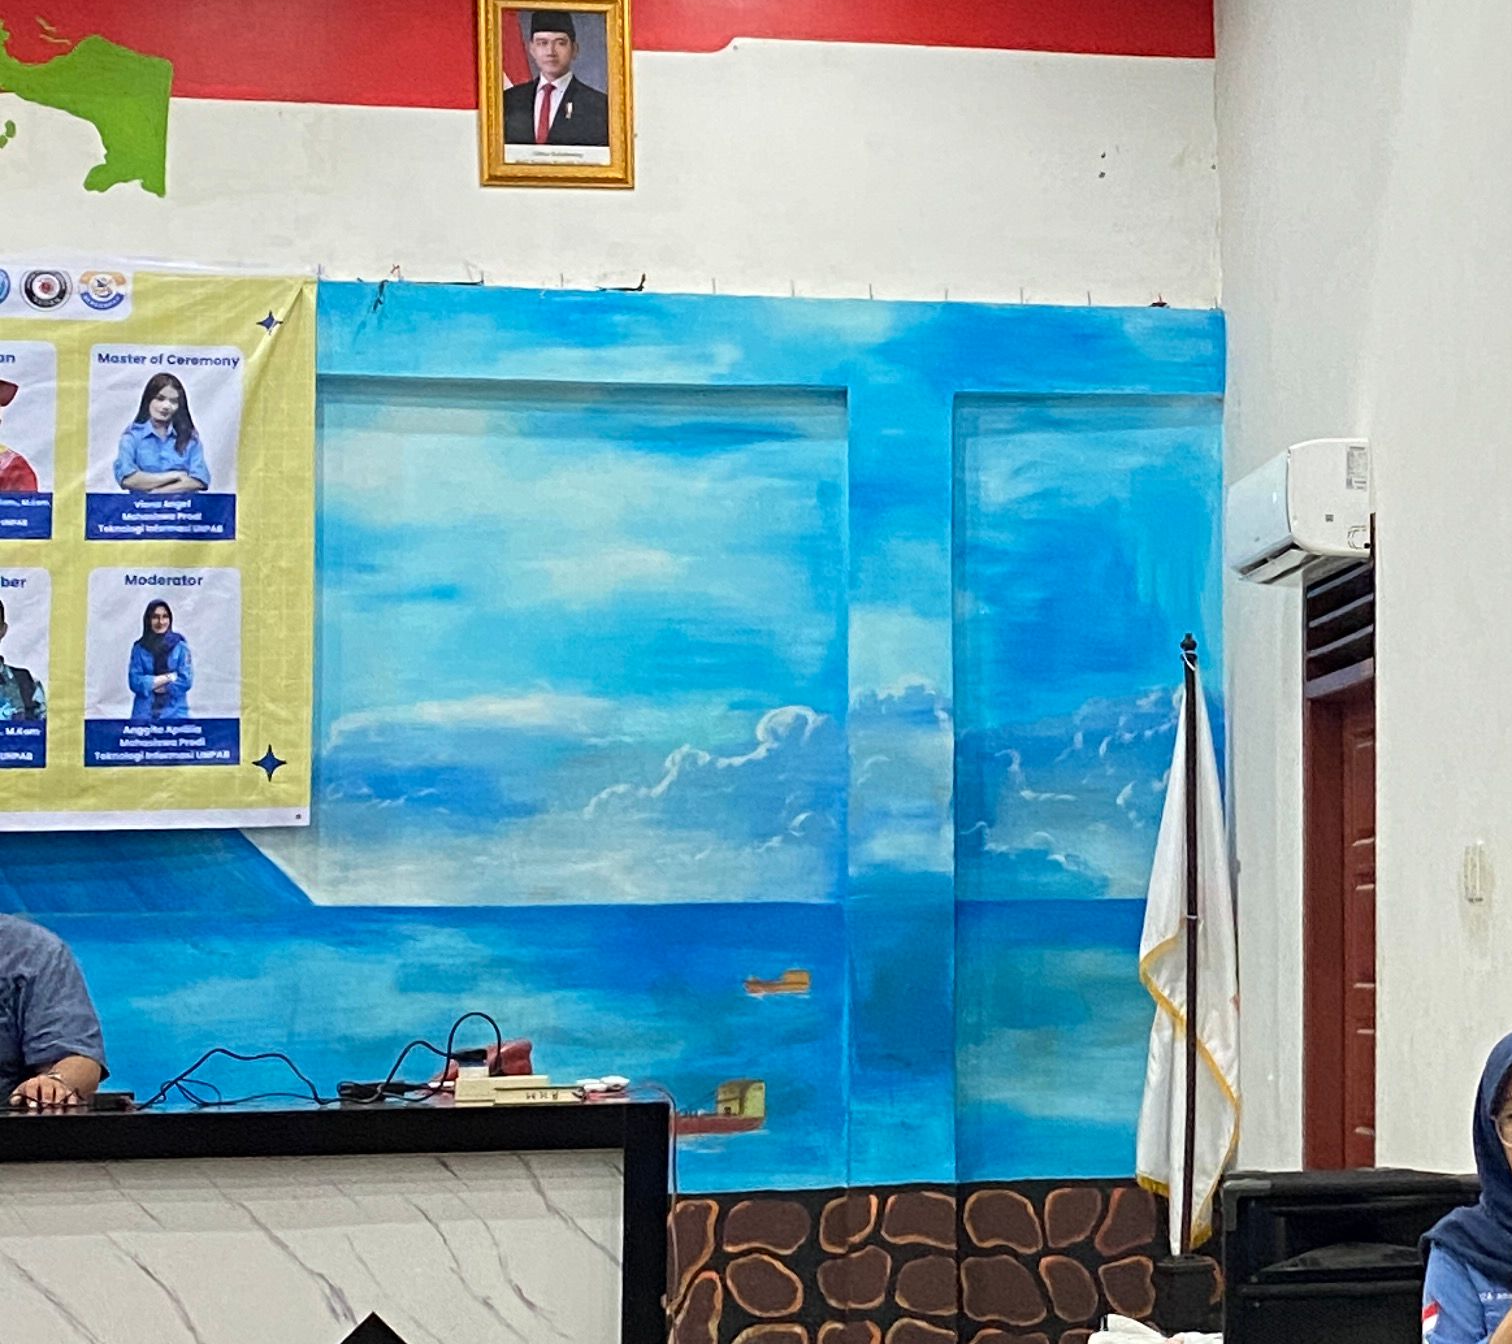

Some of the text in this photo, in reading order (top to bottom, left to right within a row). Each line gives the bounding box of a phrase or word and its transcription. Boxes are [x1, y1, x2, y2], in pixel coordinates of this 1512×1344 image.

[97, 353, 240, 369] Master of Ceremony
[124, 574, 203, 587] Moderator
